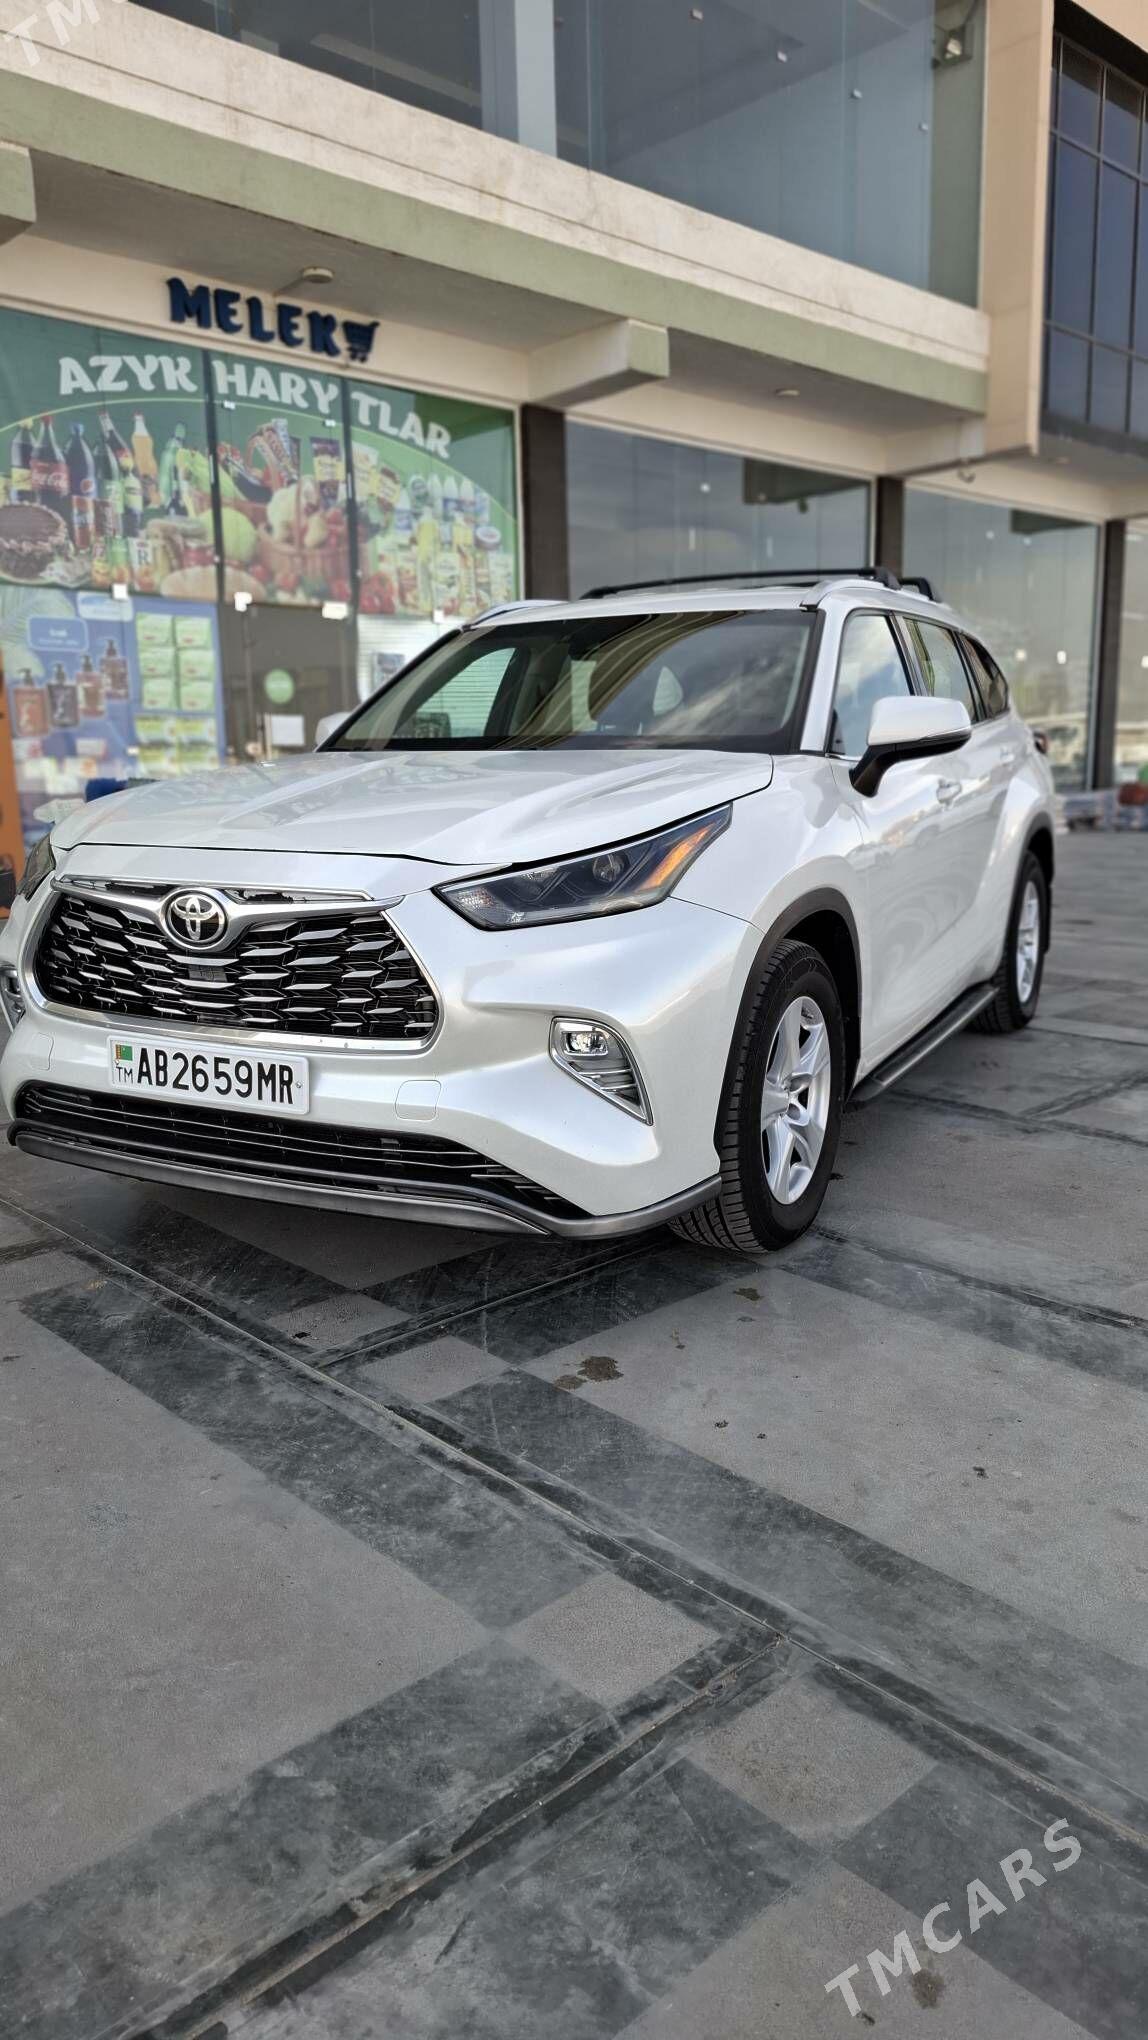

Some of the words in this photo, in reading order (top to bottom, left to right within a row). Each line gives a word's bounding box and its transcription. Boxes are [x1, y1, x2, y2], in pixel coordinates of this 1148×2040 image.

[166, 277, 341, 357] MELEK
[59, 354, 198, 396] AZYK
[212, 359, 339, 414] HARY
[351, 390, 452, 460] TLAR
[115, 1065, 134, 1085] TM
[137, 1047, 294, 1105] AB2659MR
